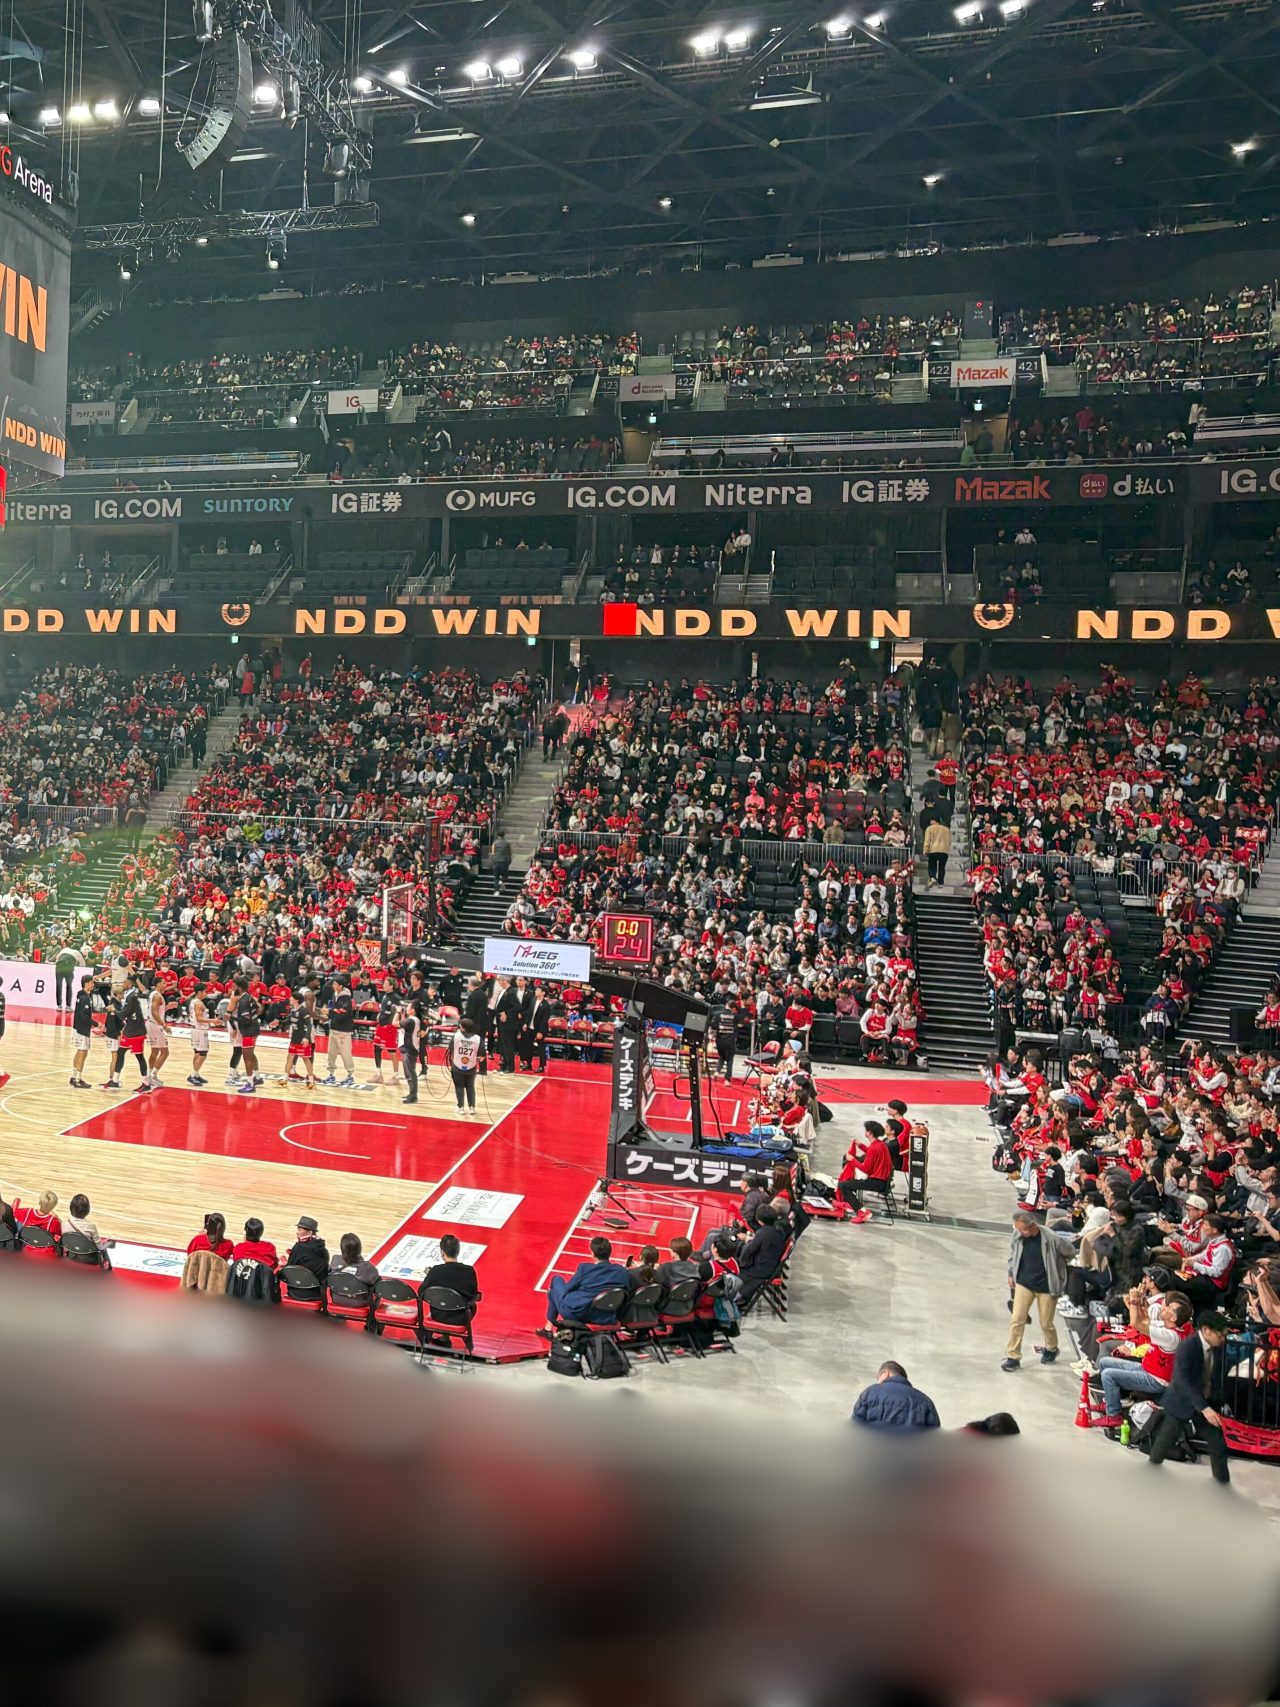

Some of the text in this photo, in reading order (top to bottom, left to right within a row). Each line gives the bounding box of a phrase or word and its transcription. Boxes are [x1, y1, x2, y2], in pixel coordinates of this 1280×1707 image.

[14, 155, 53, 205] Arena
[930, 366, 950, 375] 422
[957, 366, 1009, 380] Mazak
[1018, 361, 1038, 371] 421
[346, 396, 361, 408] IG
[5, 417, 66, 460] NDD WIN
[705, 482, 812, 506] Niterra
[842, 479, 930, 503] IG証券
[955, 475, 1052, 501] Mazak
[1113, 474, 1174, 496] d払い
[331, 492, 403, 513] IG証券
[479, 491, 536, 509] MUFG
[567, 484, 677, 509] IG.COM
[5, 501, 72, 521] iterra
[94, 497, 182, 519] IG.COM
[85, 609, 177, 633] WIN
[295, 609, 541, 635] NDD WIN
[635, 608, 912, 638] NDD WIN
[1075, 610, 1232, 640] NDD
[617, 920, 639, 935] 0.0
[613, 936, 643, 957] 24
[512, 961, 538, 969] Solution
[458, 1046, 474, 1057] 027
[619, 1036, 635, 1111] ケーズデンキ
